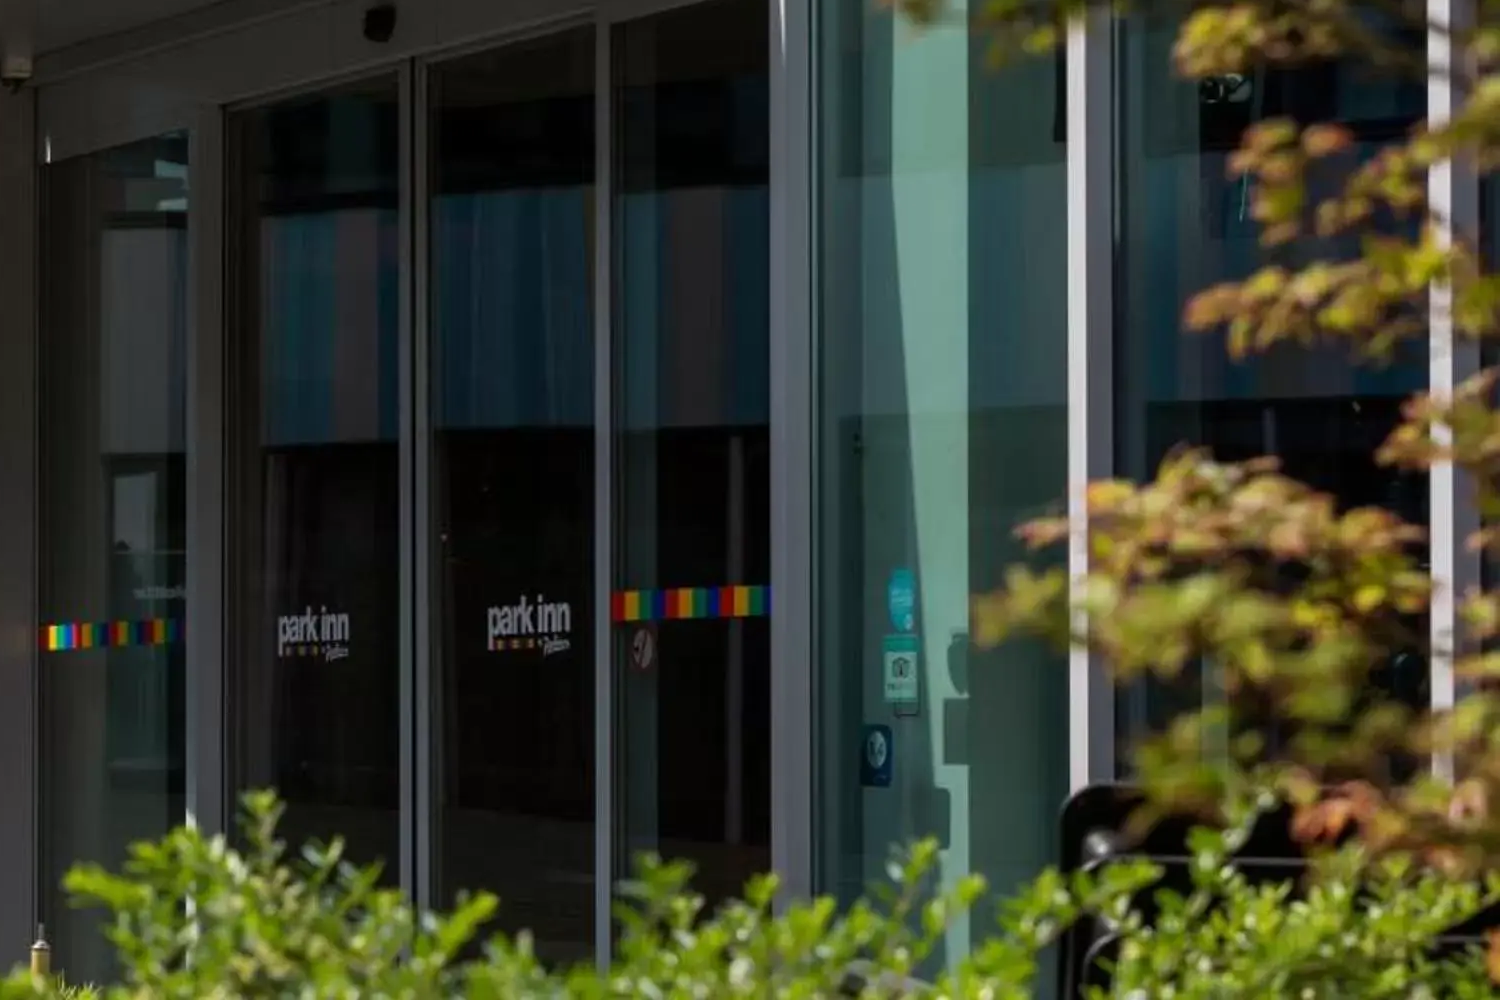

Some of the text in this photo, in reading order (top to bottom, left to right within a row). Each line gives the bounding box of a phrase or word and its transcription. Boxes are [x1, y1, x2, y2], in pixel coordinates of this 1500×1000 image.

[277, 605, 319, 657] park
[320, 605, 349, 642] inn
[487, 594, 535, 650] park
[536, 593, 571, 633] inn
